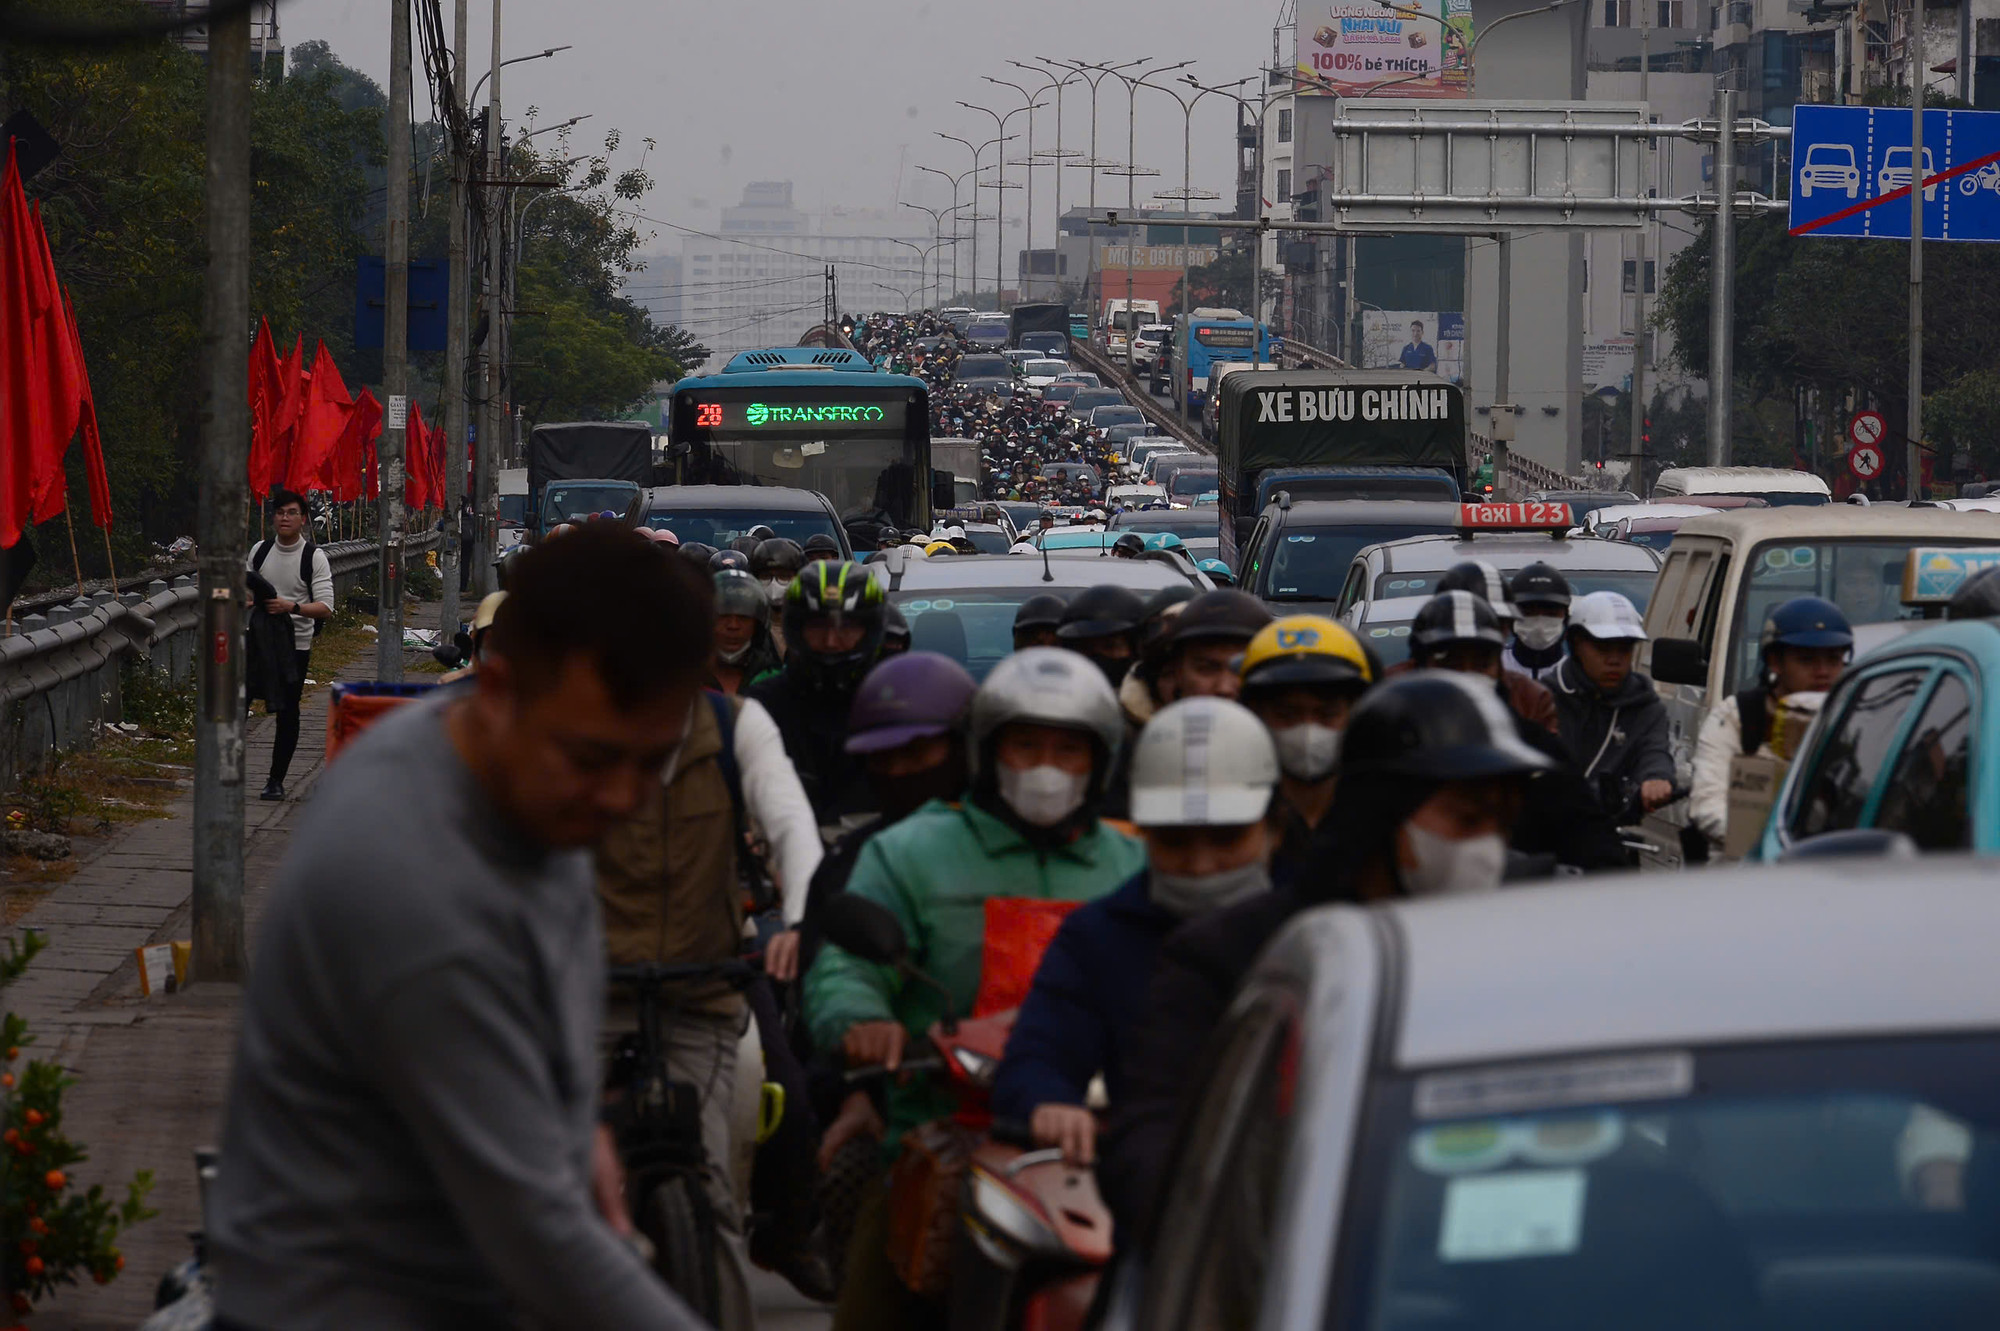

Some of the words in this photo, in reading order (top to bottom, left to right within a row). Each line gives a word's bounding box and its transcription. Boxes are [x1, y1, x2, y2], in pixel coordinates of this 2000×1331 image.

[1312, 53, 1362, 70] 100%
[1385, 57, 1428, 71] THÍCH
[1150, 249, 1183, 266] 0916
[1257, 391, 1294, 422] XE
[1299, 387, 1355, 422] BƯU
[1362, 384, 1449, 421] CHÍNH
[696, 403, 722, 426] 28
[1466, 503, 1512, 523] Taxi
[1278, 628, 1319, 649] be
